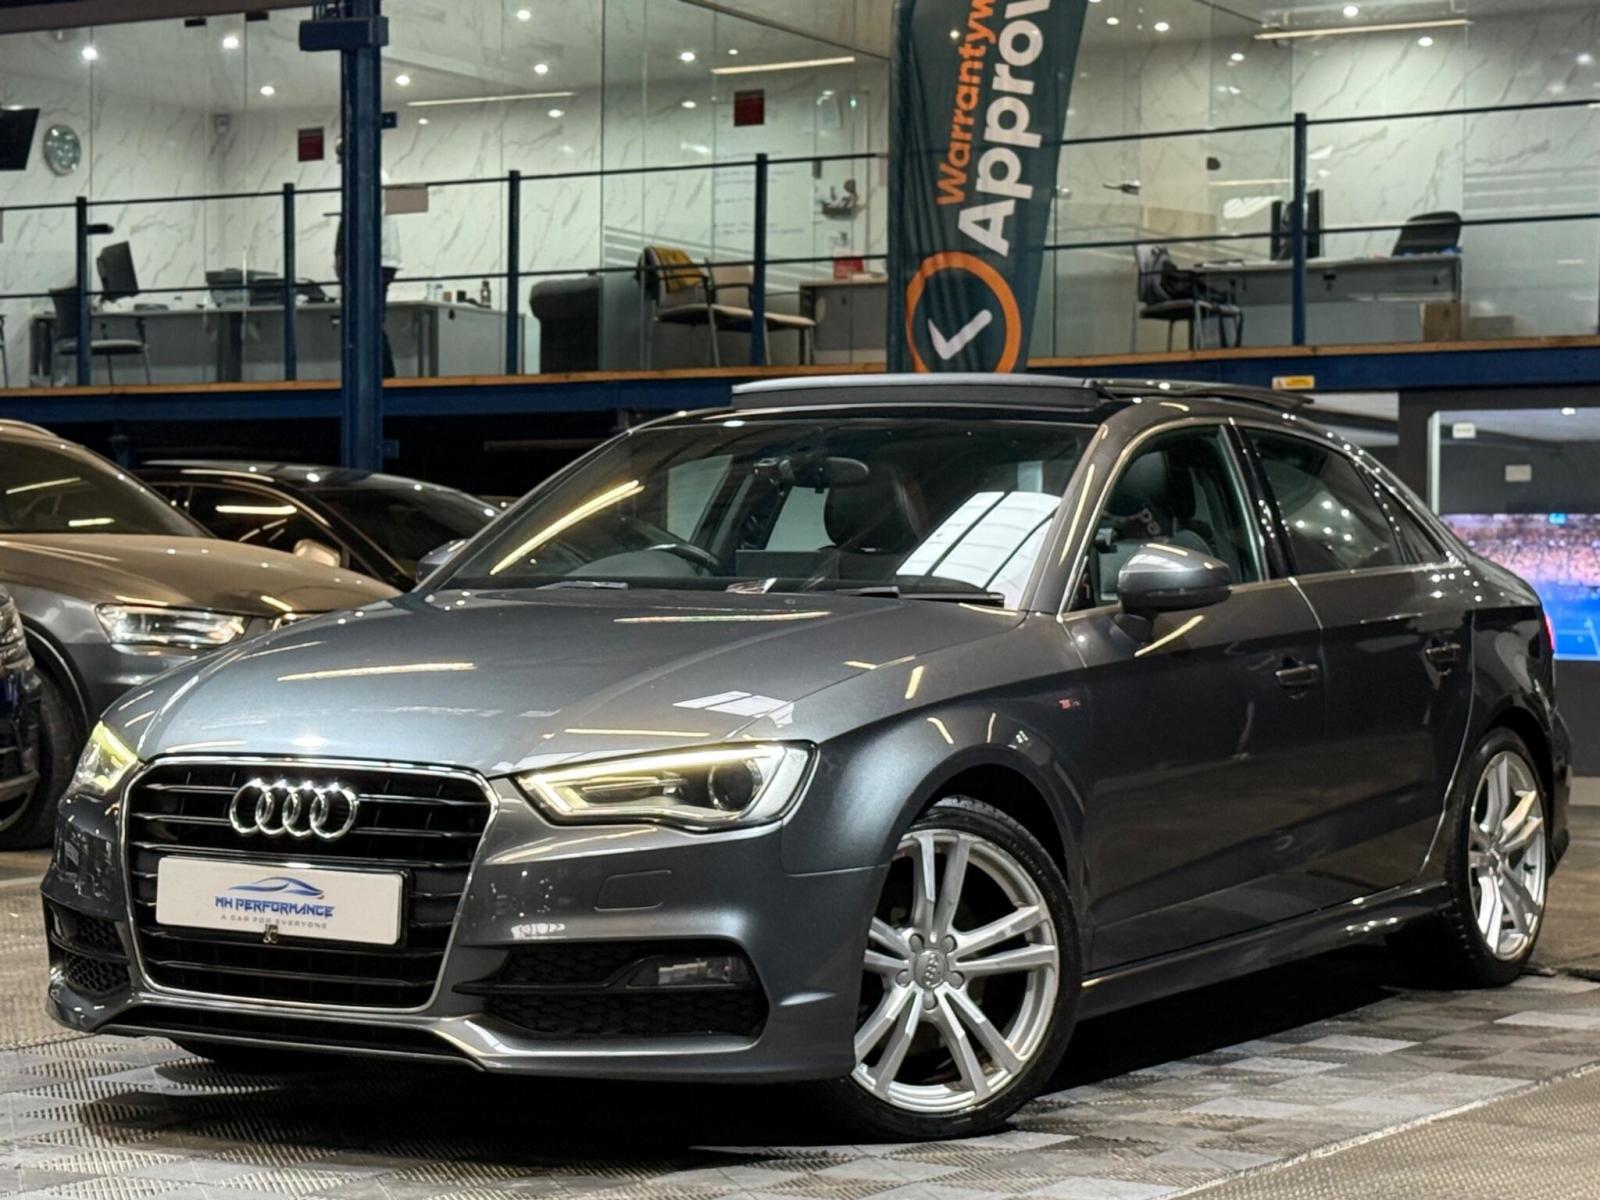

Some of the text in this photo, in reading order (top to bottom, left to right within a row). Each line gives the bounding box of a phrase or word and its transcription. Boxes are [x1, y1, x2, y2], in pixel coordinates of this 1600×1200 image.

[215, 896, 335, 918] MH PERFORMANCE
[230, 915, 250, 923] CAR
[275, 919, 328, 930] EVERYONE
